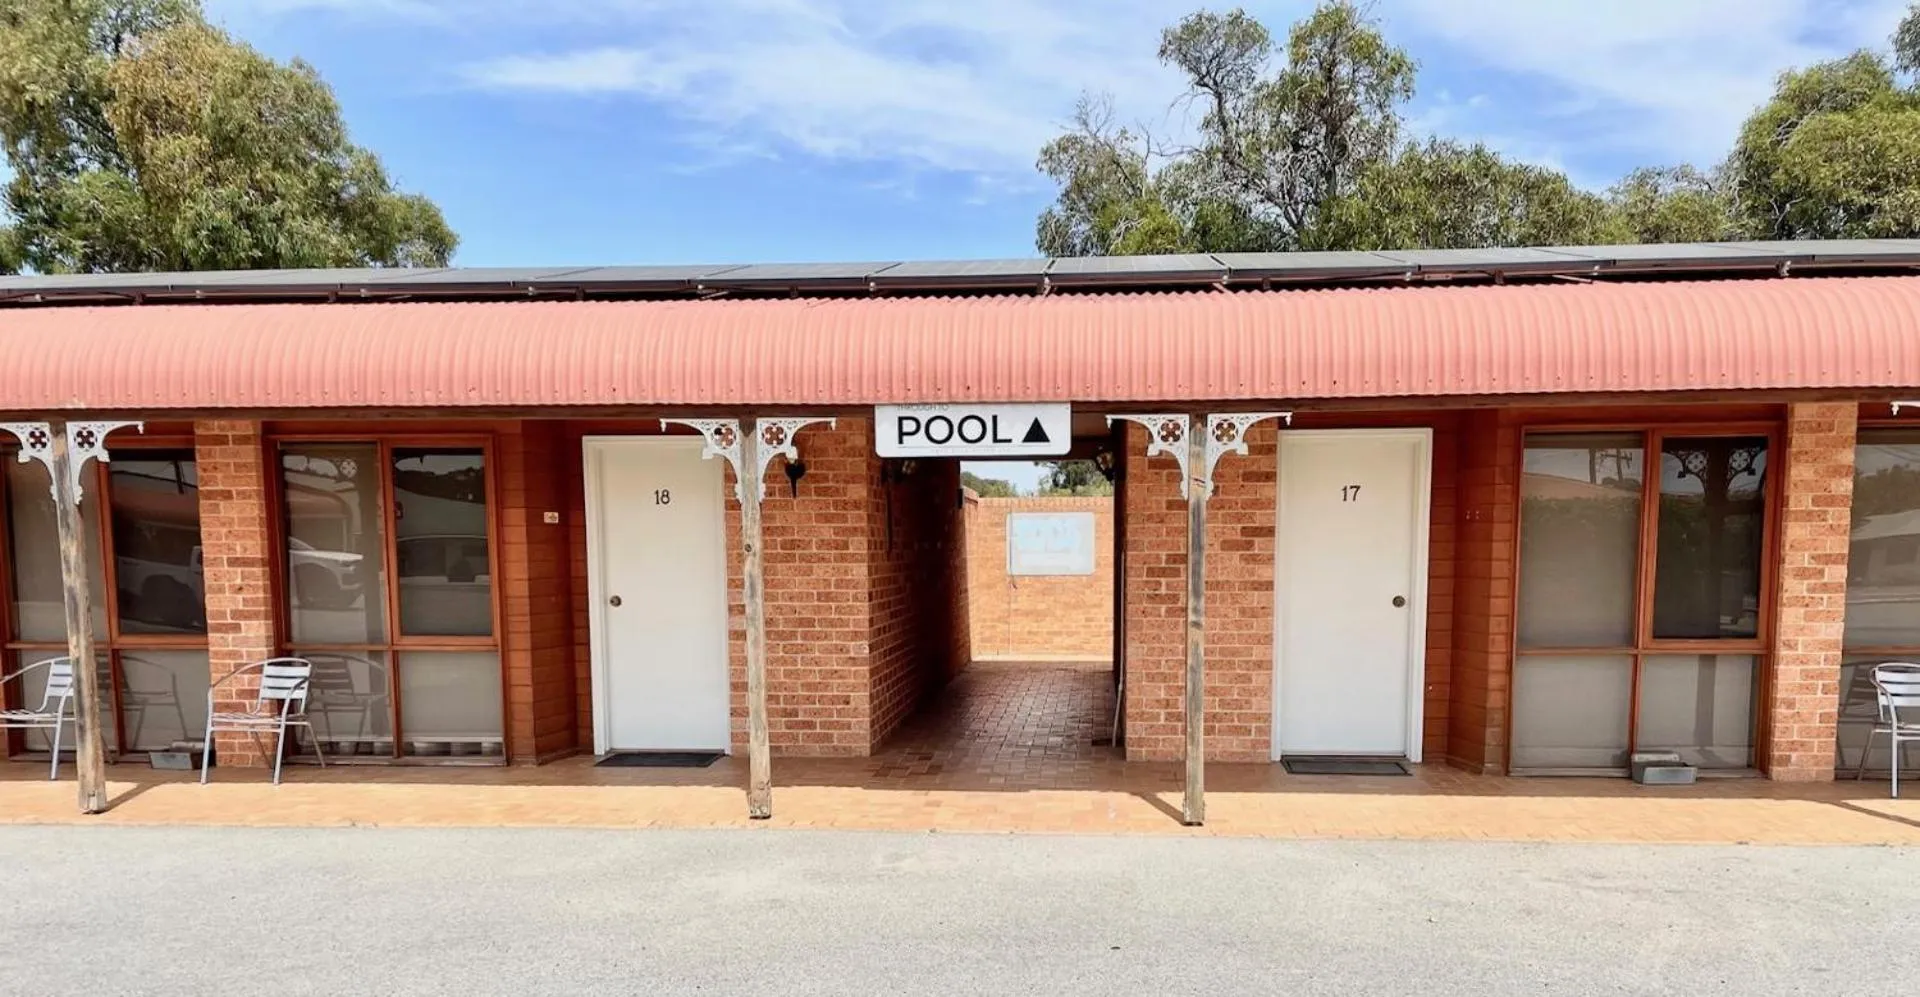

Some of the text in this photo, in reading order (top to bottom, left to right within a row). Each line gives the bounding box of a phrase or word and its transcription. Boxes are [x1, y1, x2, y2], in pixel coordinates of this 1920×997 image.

[898, 415, 1012, 444] POOL
[654, 489, 670, 505] 18
[1341, 485, 1361, 502] 17
